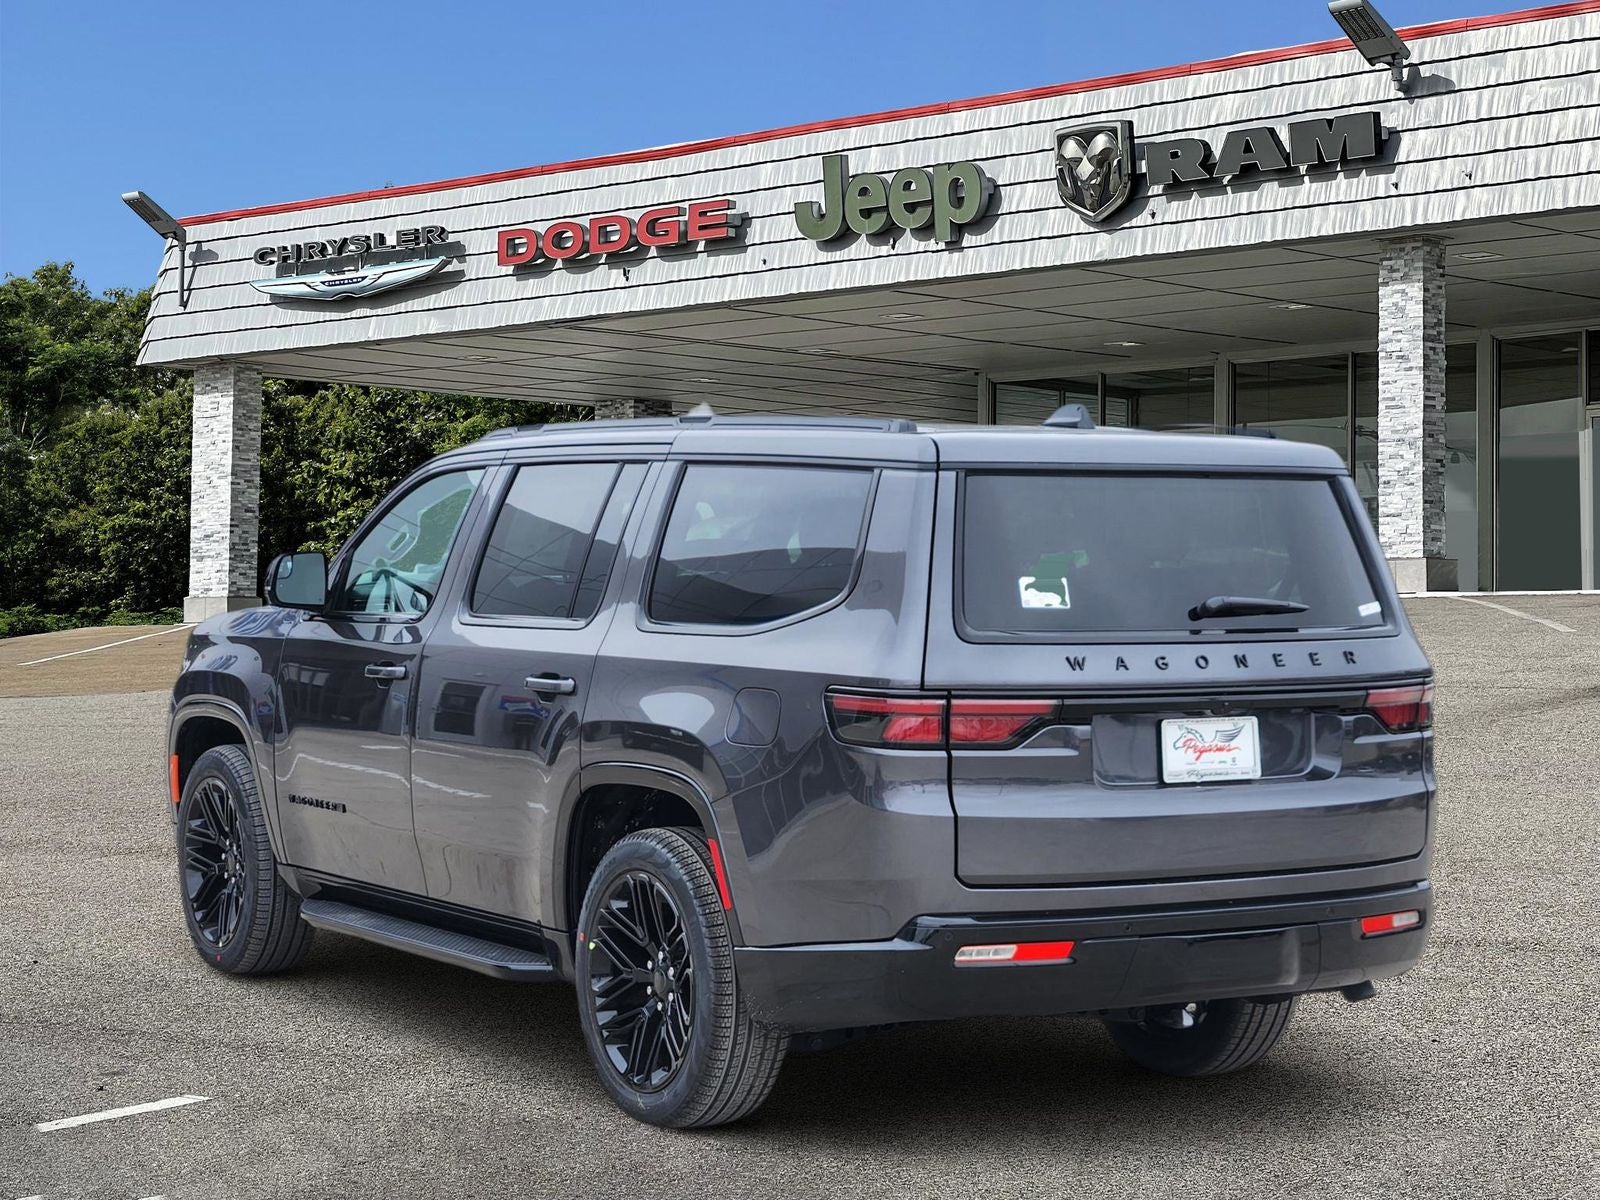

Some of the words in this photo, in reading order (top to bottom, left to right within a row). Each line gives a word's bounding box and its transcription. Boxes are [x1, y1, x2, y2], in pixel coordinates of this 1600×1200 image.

[1146, 111, 1381, 187] RAM
[794, 154, 988, 245] Jeep
[253, 225, 449, 266] CHRYSLER
[497, 199, 735, 267] DODGE
[324, 277, 363, 286] CHRYSLER
[1066, 650, 1357, 671] WAGONEER
[1182, 738, 1241, 761] Pegasus
